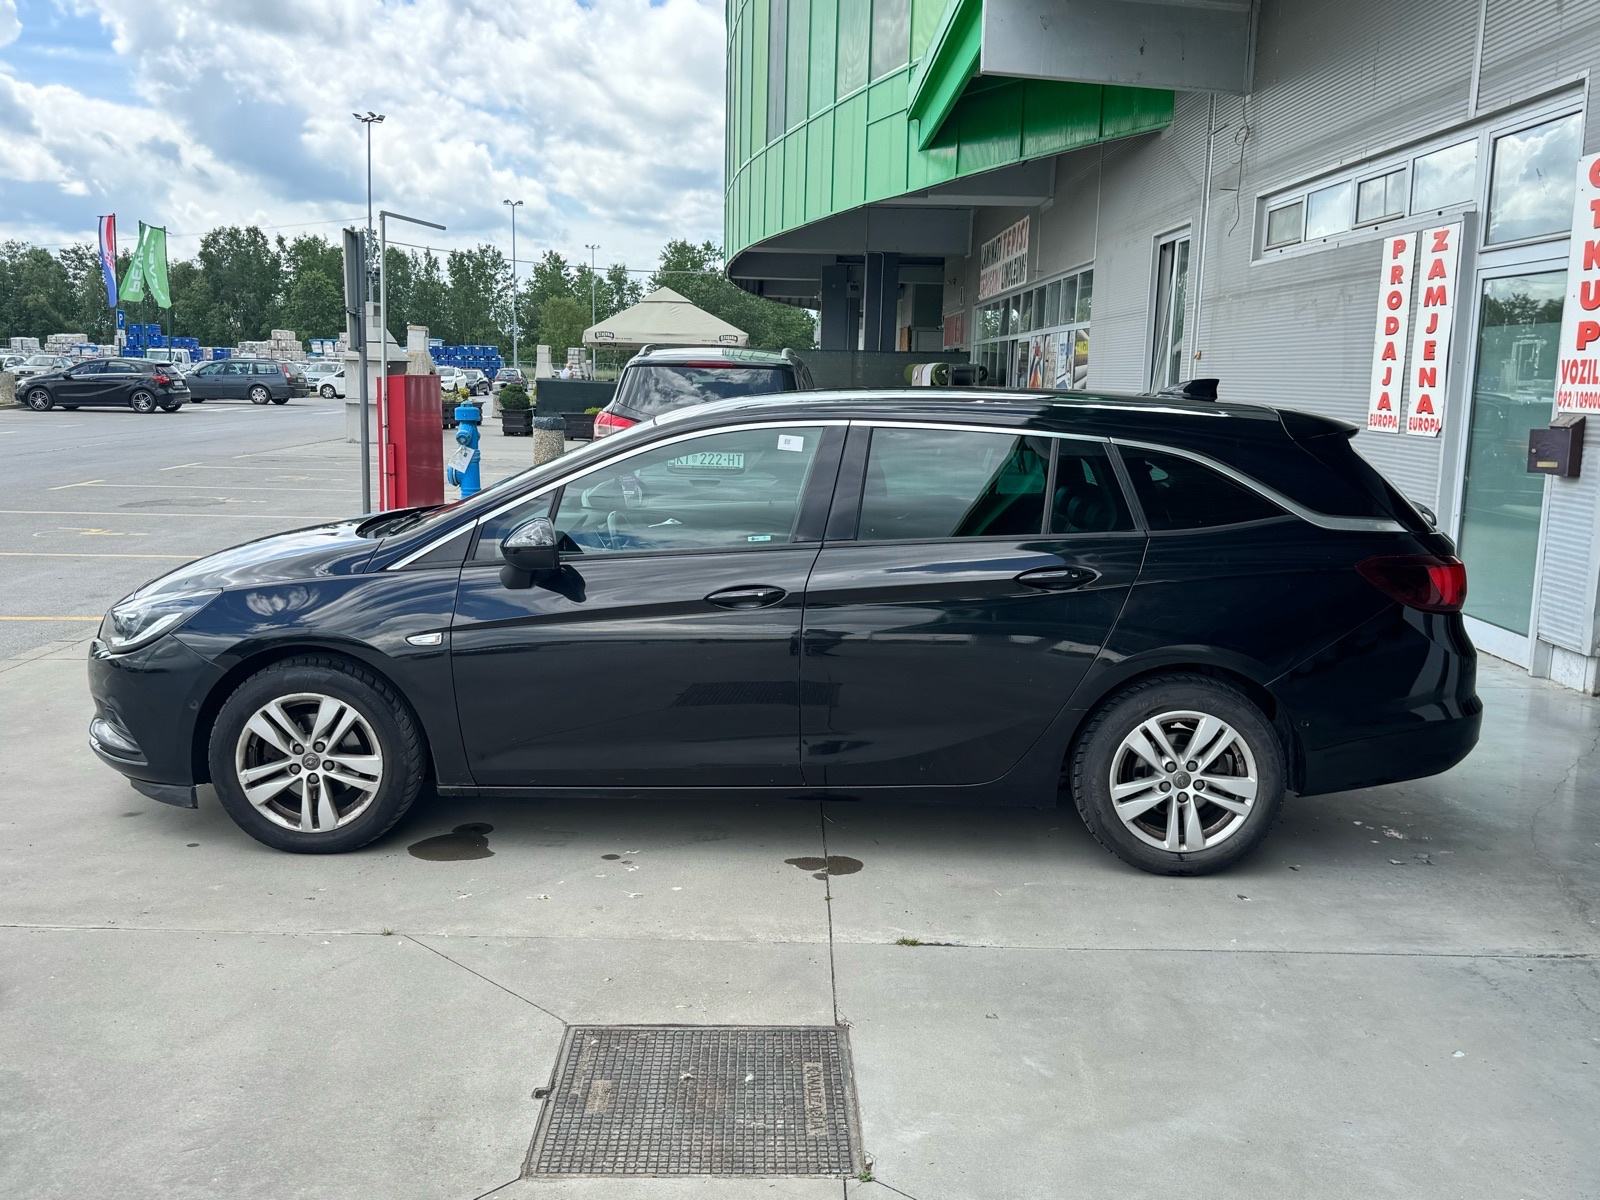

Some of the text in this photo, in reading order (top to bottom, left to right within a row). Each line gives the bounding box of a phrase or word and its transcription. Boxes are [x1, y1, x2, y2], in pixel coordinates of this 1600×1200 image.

[1377, 239, 1406, 411] PRODAJA
[1416, 229, 1450, 415] ZAMJENA
[1561, 359, 1600, 385] VOZIL
[1369, 413, 1397, 429] EUROPA
[1408, 417, 1441, 433] EUROPA
